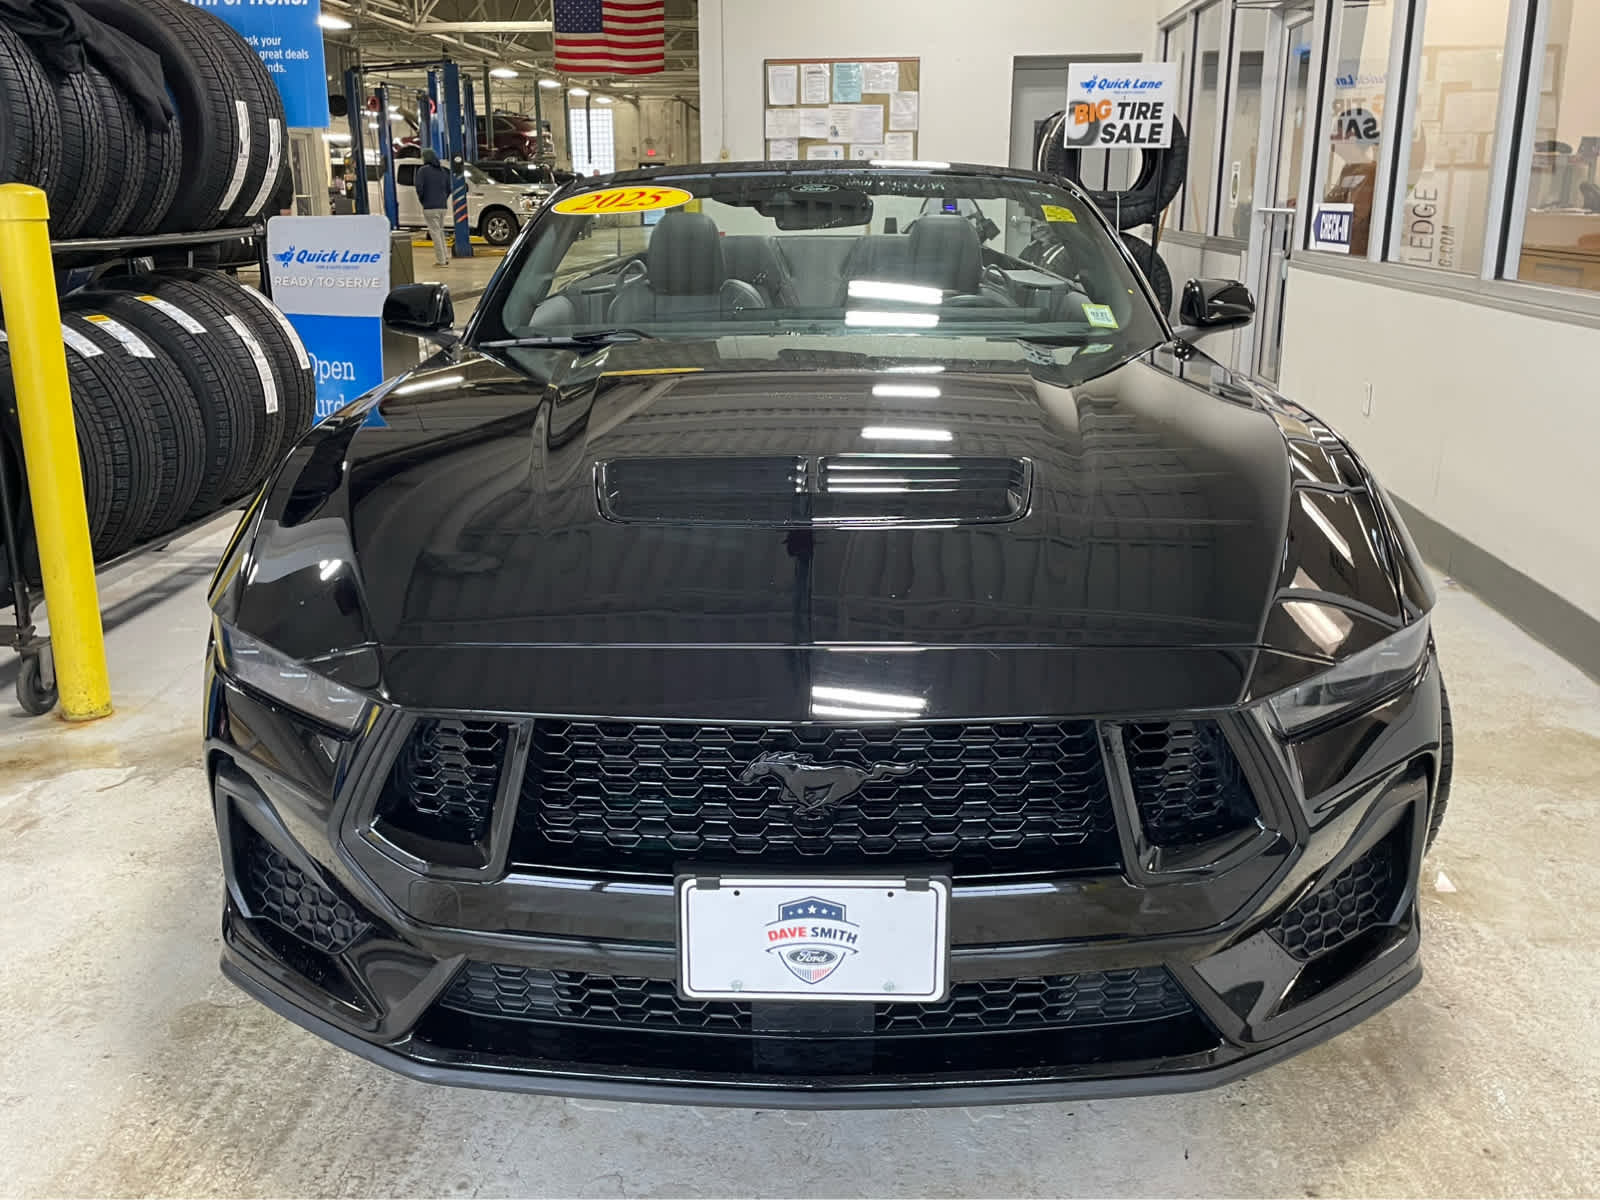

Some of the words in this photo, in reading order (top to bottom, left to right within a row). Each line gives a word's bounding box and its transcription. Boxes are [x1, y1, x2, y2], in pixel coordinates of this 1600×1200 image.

[261, 37, 281, 47] your
[259, 49, 283, 60] great
[285, 49, 309, 60] deals
[267, 62, 287, 73] nds.
[1098, 78, 1131, 90] Quick
[1133, 79, 1163, 89] Lane
[1075, 99, 1112, 126] BIG
[1117, 102, 1164, 120] TIRE
[1100, 122, 1164, 144] SALE
[571, 190, 673, 211] 2025
[1320, 213, 1350, 242] CHECK-IN
[1408, 188, 1438, 263] LEDGE
[296, 249, 339, 264] Quick
[341, 250, 381, 263] Lane
[274, 276, 314, 287] READY
[316, 277, 334, 287] TO
[336, 277, 382, 288] SERVE
[768, 926, 807, 942] DAVE
[810, 926, 859, 945] SMITH
[795, 949, 830, 963] Ford
